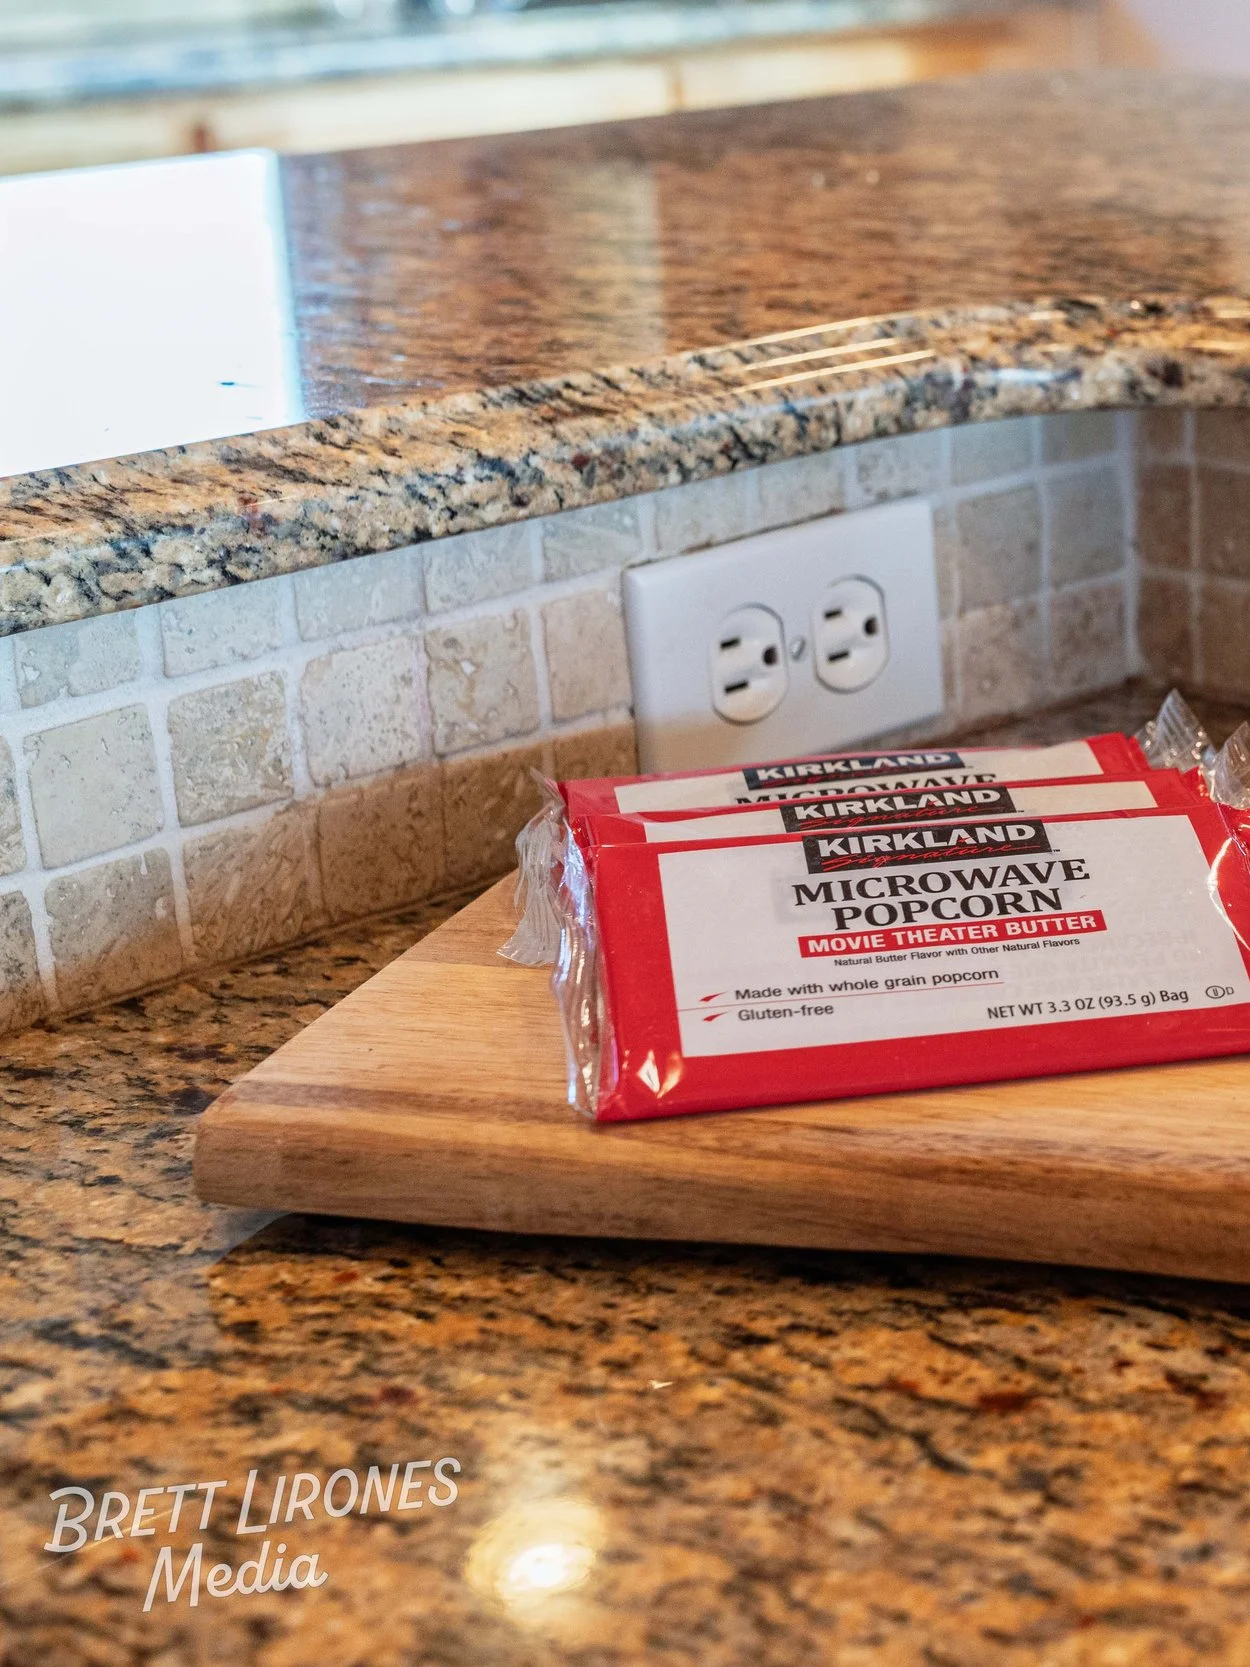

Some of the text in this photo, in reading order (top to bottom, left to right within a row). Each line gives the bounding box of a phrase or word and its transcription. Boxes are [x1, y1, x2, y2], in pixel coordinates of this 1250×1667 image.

[756, 753, 951, 781] KIRKLAND
[794, 789, 1001, 820] KIRKLAND
[817, 824, 1036, 857] KIRKLAND
[821, 844, 1041, 871] Signature
[792, 858, 1090, 906] MICROWAVE
[831, 887, 1063, 930] POPCORN
[807, 915, 1097, 953] MOVIE THEATER BUTTER
[834, 937, 1080, 967] Natural Butter Flavor with Other Natural Flavors
[734, 968, 999, 1000] Made with whole grain popcorn
[738, 1003, 834, 1021] Gluten-free
[987, 989, 1189, 1019] NET WT 3.3 OZ (93.5 g) Bag
